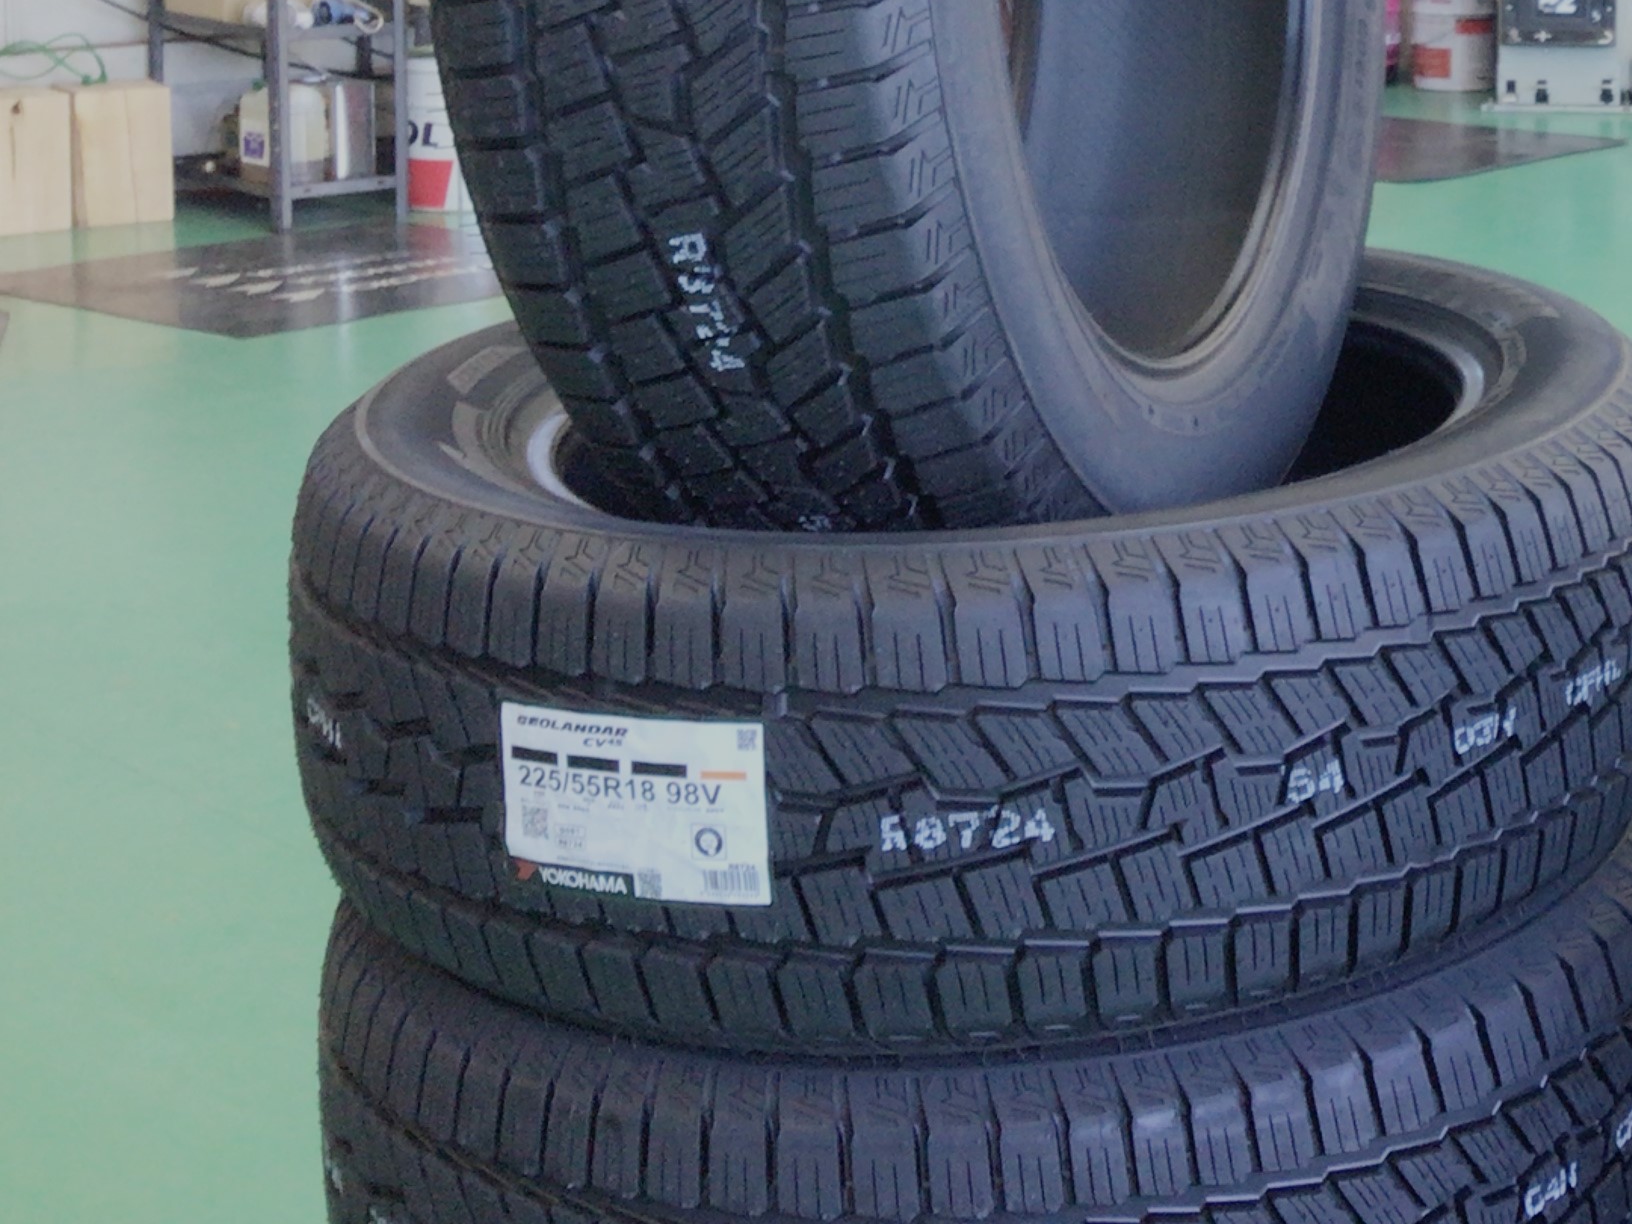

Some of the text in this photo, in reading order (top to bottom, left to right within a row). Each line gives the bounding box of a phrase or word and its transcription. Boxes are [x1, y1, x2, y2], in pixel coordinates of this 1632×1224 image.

[516, 714, 629, 737] GEOLANDAR
[518, 764, 722, 806] 225/55R18 98V
[881, 807, 1055, 852] R8724
[538, 866, 628, 895] YOKOHAMA
